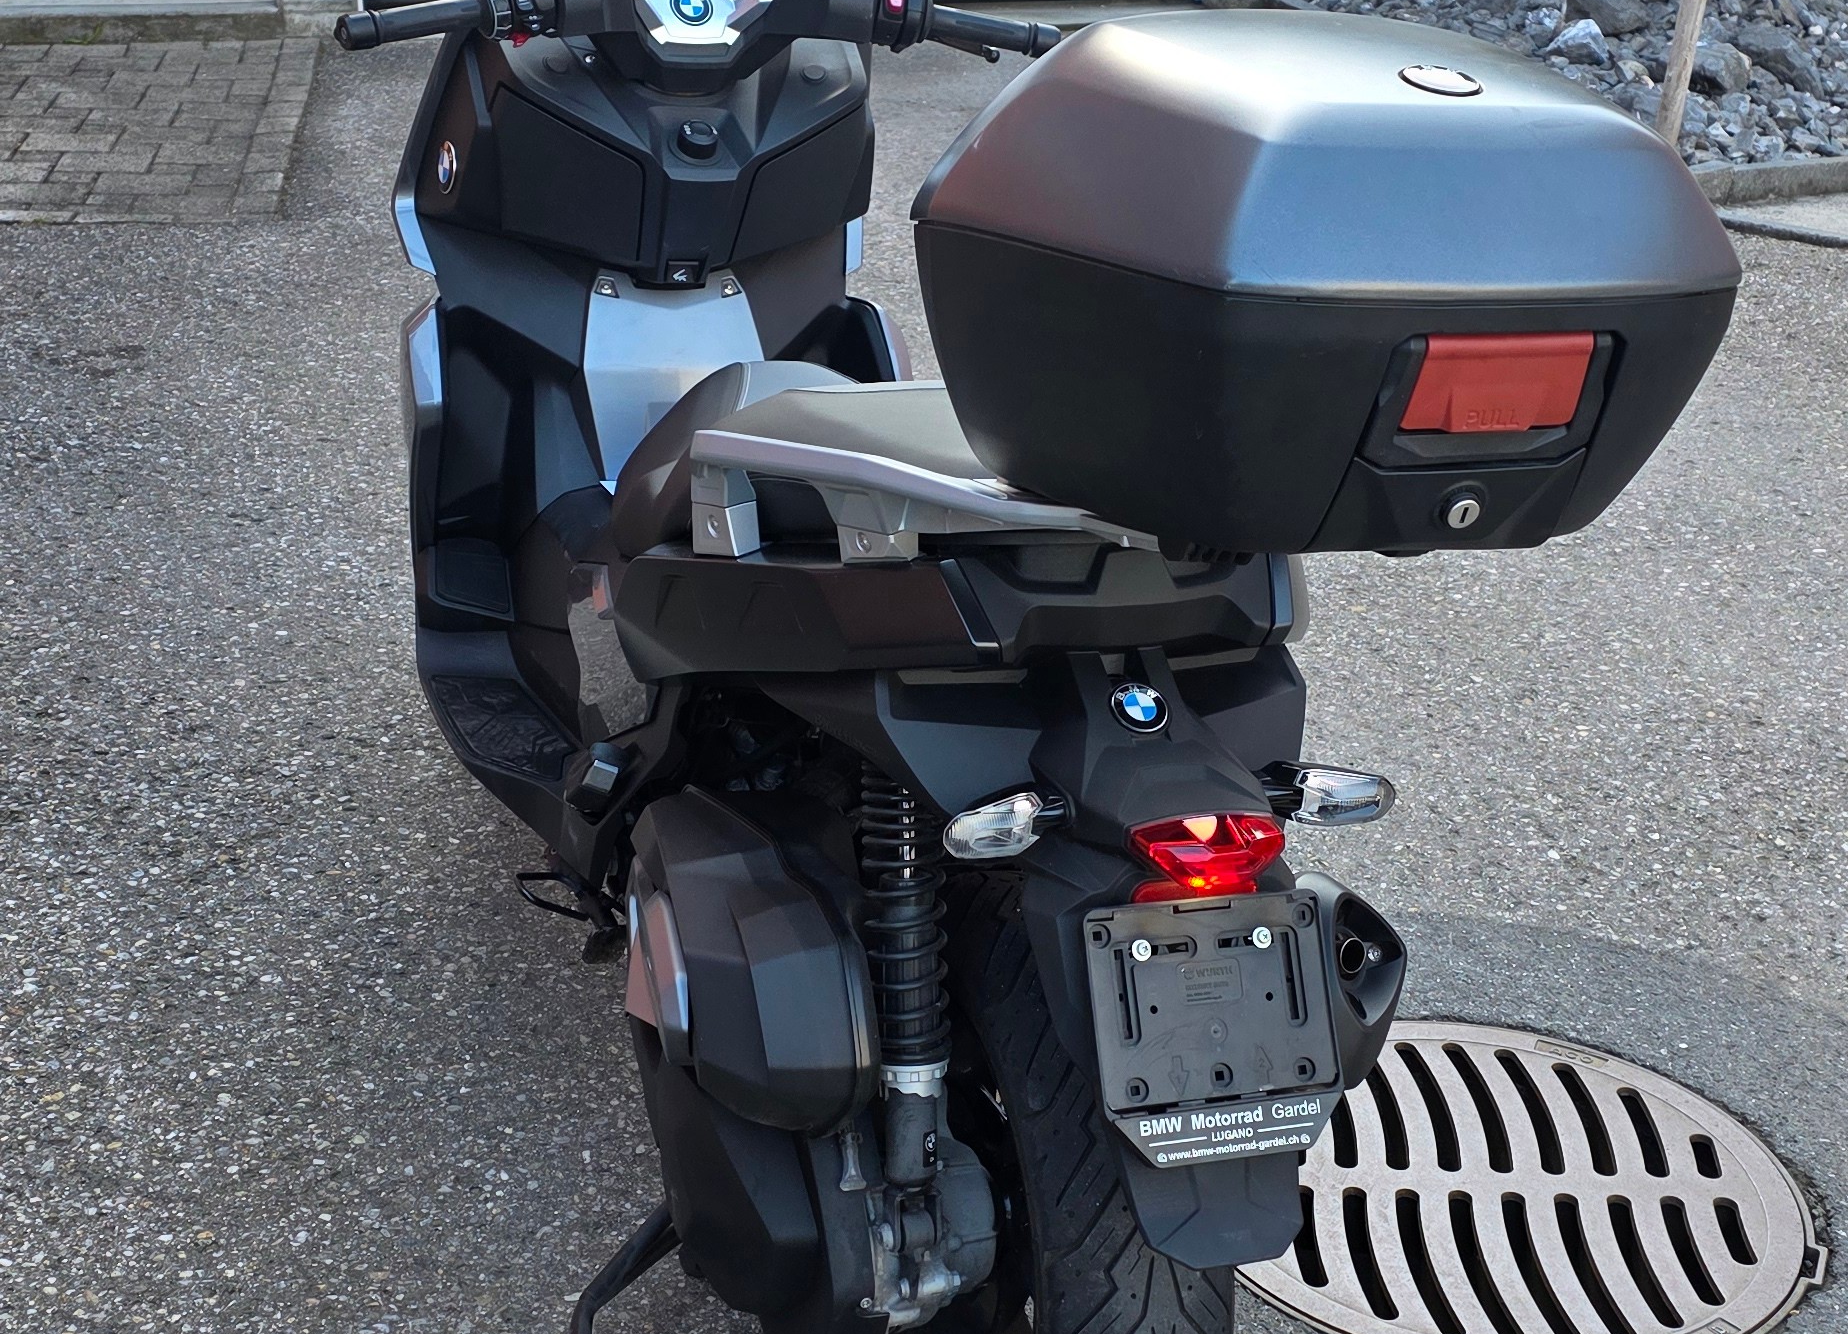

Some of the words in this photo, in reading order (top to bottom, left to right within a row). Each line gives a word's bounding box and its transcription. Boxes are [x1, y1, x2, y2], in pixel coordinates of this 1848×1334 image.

[1463, 410, 1520, 429] PULL
[1140, 1116, 1182, 1137] BMW
[1191, 1106, 1263, 1131] Motorrad
[1272, 1098, 1321, 1119] Gardel
[1211, 1128, 1254, 1142] LUGANO
[1168, 1134, 1300, 1161] www.bmw-motorrad-gardel.ch
